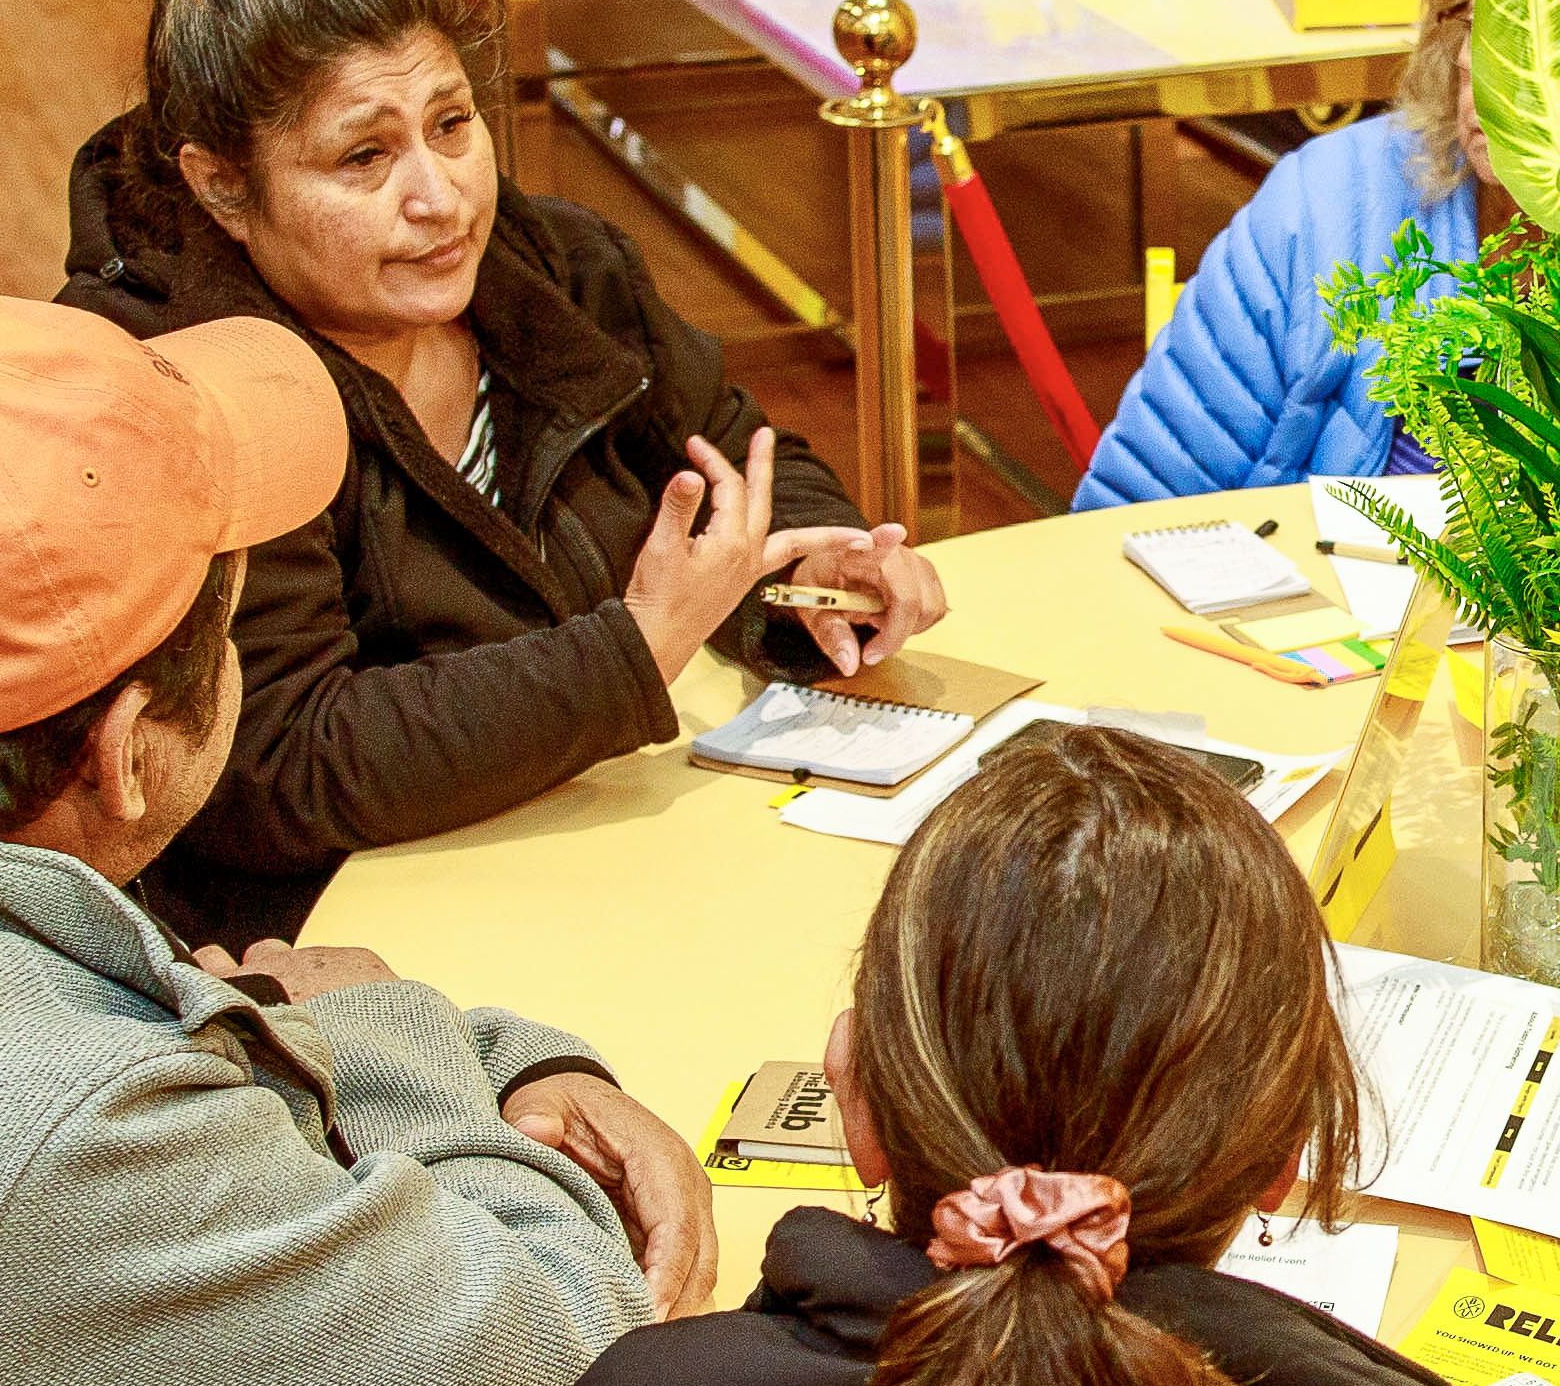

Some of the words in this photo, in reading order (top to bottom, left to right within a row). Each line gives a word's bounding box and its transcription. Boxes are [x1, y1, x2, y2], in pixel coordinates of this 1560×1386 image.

[804, 1072, 825, 1087] THE
[781, 1088, 831, 1131] hub
[1248, 1252, 1276, 1264] Relief
[1278, 1255, 1308, 1266] Event
[1434, 1330, 1456, 1339] YOU
[1456, 1336, 1500, 1352] SHOWED
[1534, 1360, 1556, 1369] GOT
